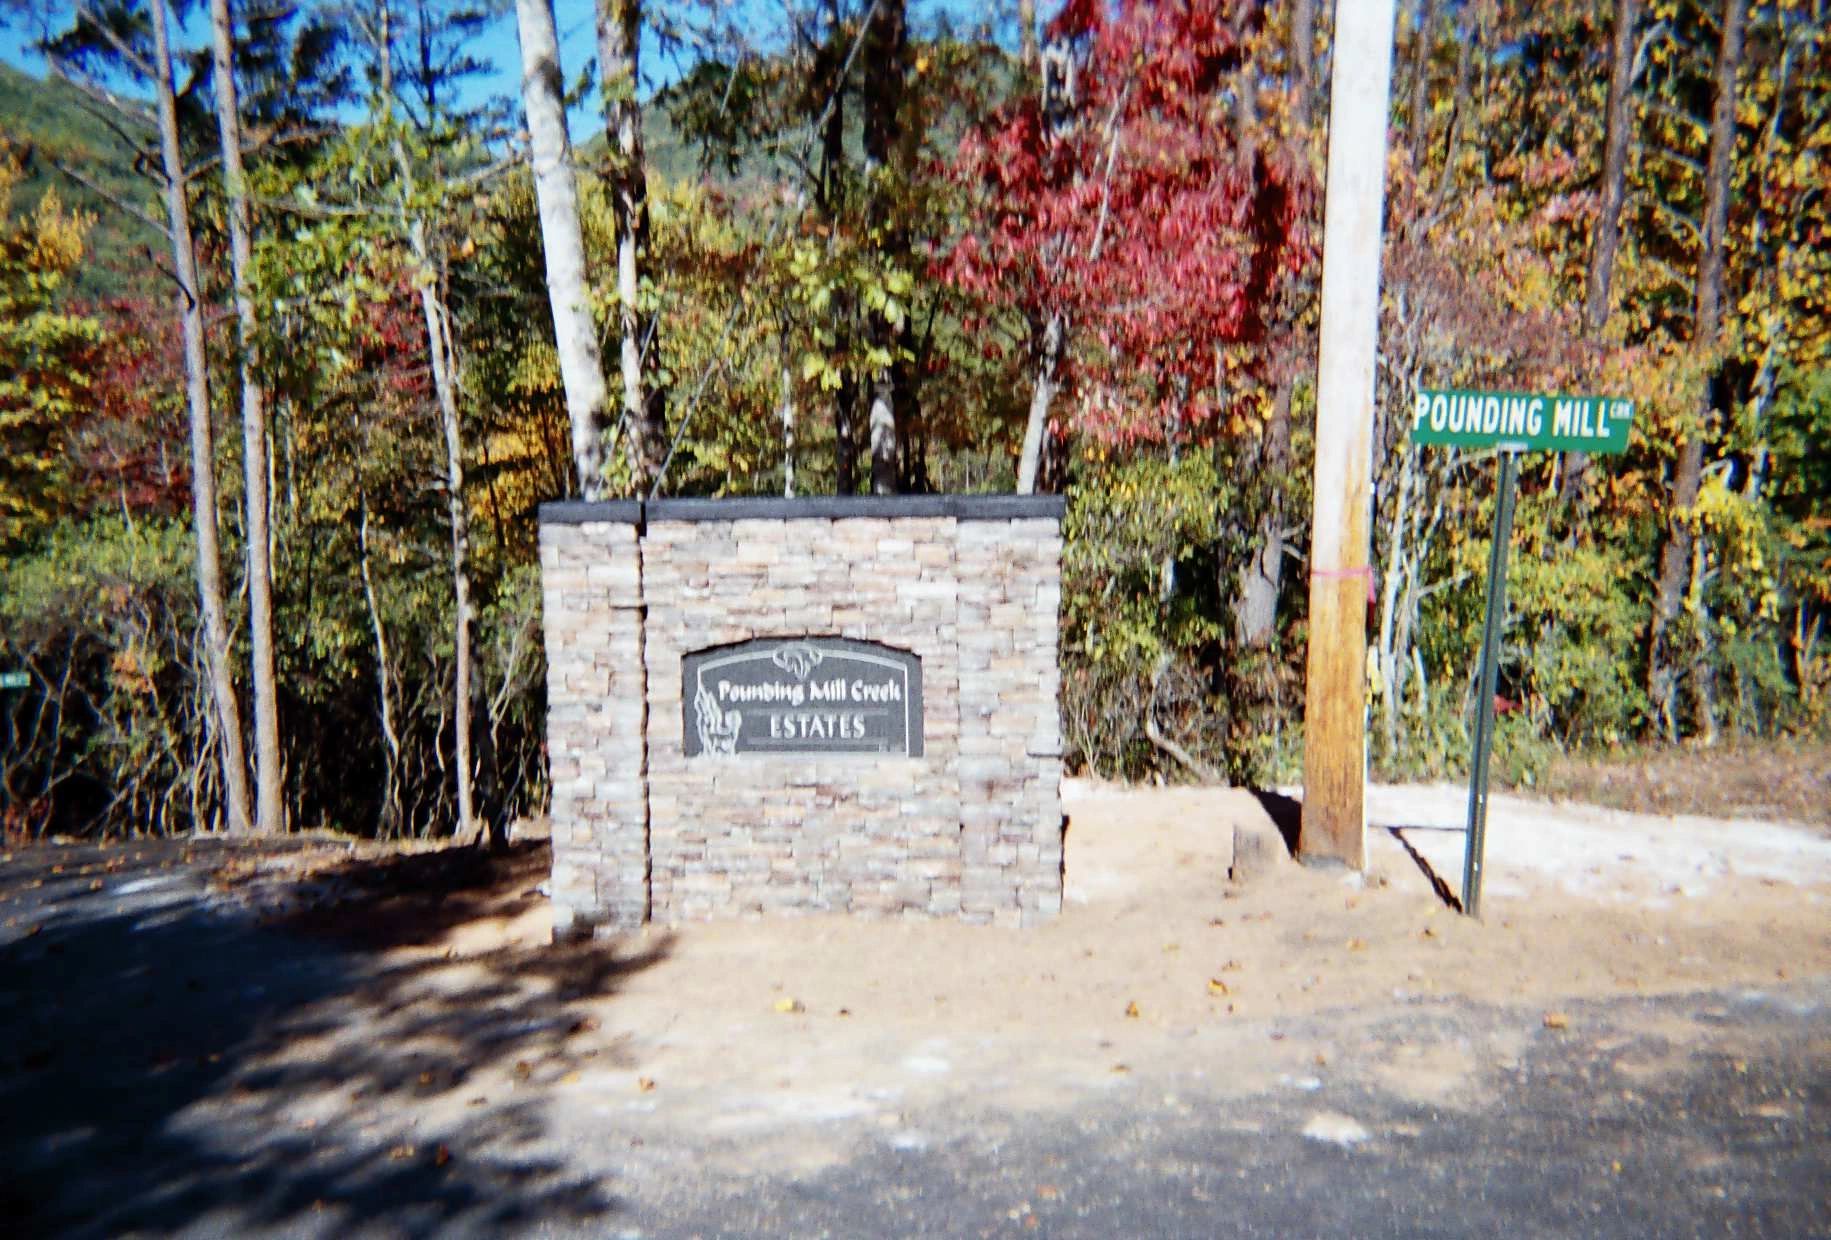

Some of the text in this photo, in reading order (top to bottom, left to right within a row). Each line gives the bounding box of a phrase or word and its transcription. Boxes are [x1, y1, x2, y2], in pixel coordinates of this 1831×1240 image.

[1413, 393, 1543, 437] POUNDING
[1552, 399, 1611, 438] MILL
[718, 678, 902, 706] Pounding Mill Creek
[770, 712, 866, 739] ESTATES
